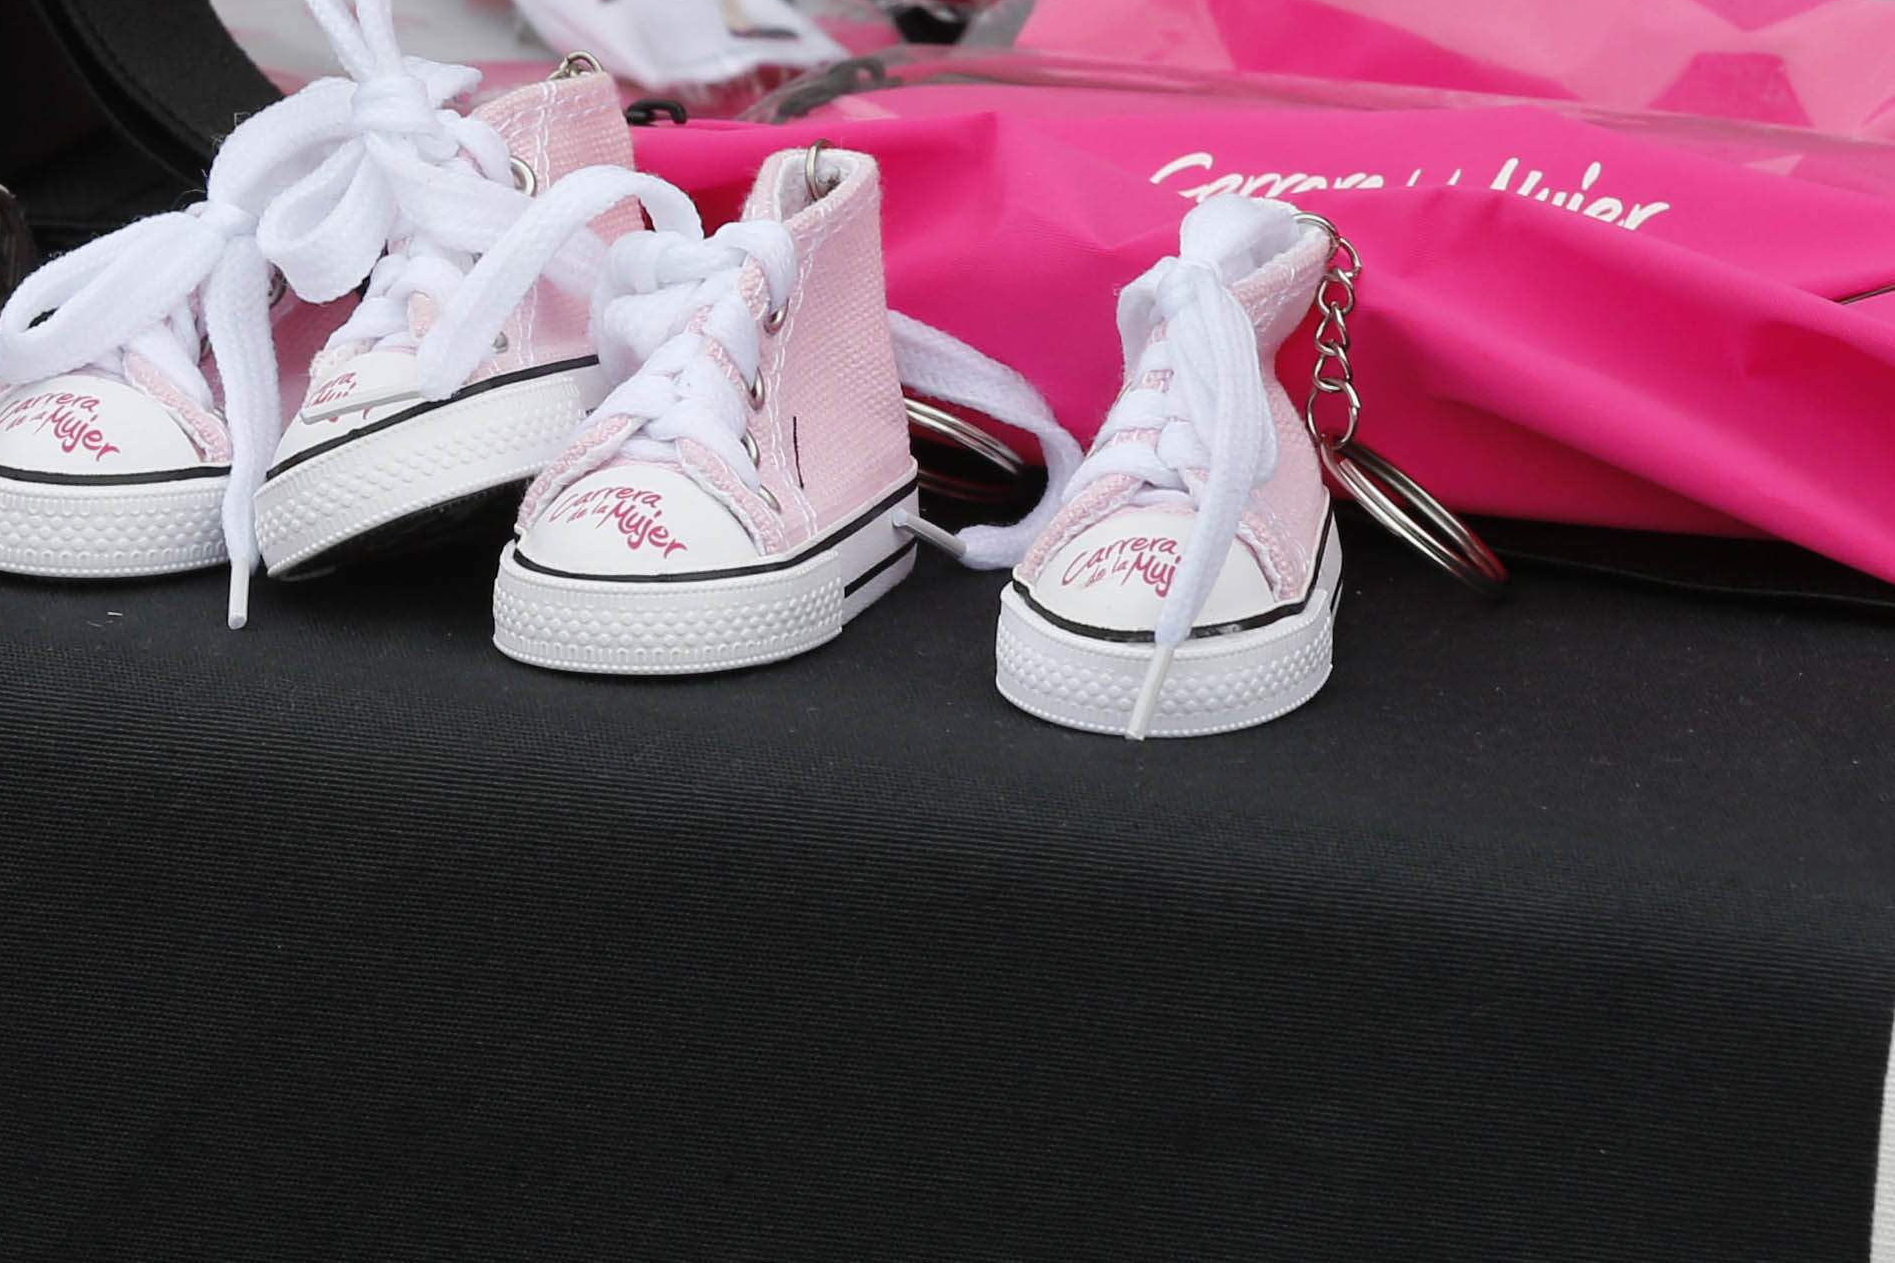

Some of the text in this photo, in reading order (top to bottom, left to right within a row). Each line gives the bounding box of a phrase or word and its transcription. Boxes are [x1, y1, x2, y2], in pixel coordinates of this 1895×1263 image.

[34, 406, 121, 462] Mujer
[548, 486, 662, 523] Carrera
[596, 499, 688, 559] Mujer
[1062, 537, 1178, 586] Carrera
[1121, 552, 1182, 597] Muj
